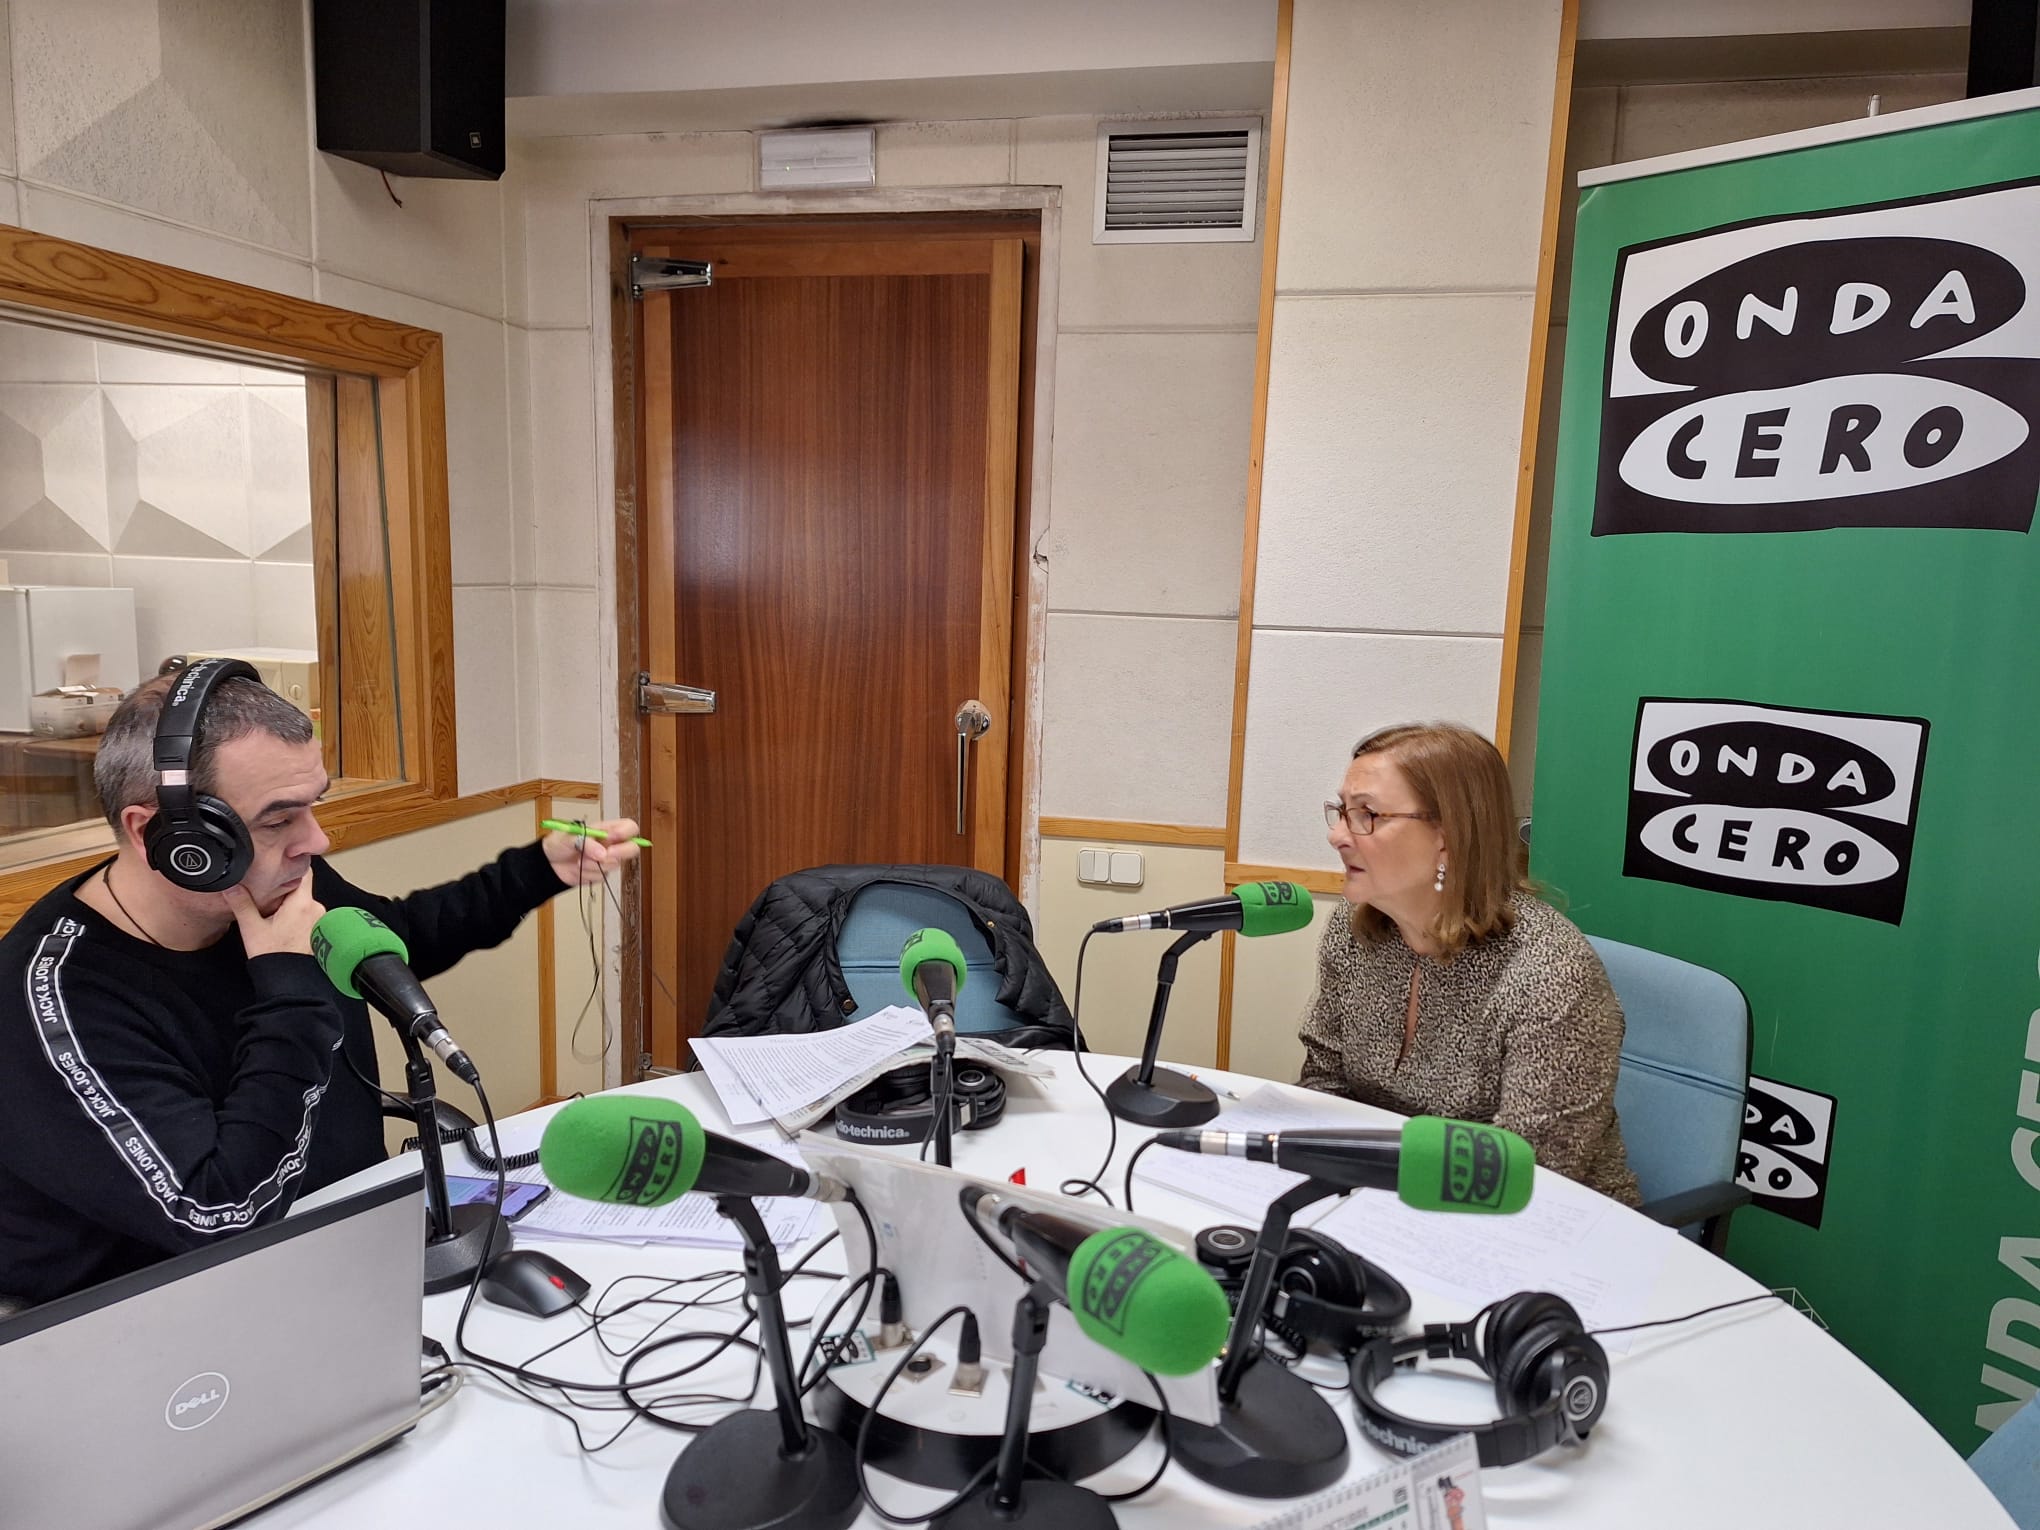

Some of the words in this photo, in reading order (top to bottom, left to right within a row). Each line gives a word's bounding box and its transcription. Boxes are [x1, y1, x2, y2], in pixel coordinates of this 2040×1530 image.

[1664, 269, 1976, 359] ONDA
[1666, 403, 1964, 480] CERO
[1669, 739, 1867, 795] ONDA
[1672, 813, 1860, 876] CERO
[35, 956, 55, 983] JONES
[35, 983, 50, 992] &
[36, 991, 58, 1024] JACK
[58, 1051, 91, 1086] JONES
[83, 1085, 97, 1096] &
[88, 1093, 116, 1118] JACK
[124, 1136, 158, 1172] JONES
[620, 1133, 655, 1200] ONDA
[643, 1135, 674, 1198] CERO
[1453, 1133, 1470, 1193] CERO
[1477, 1134, 1496, 1197] ONDA
[175, 1388, 221, 1416] DELL
